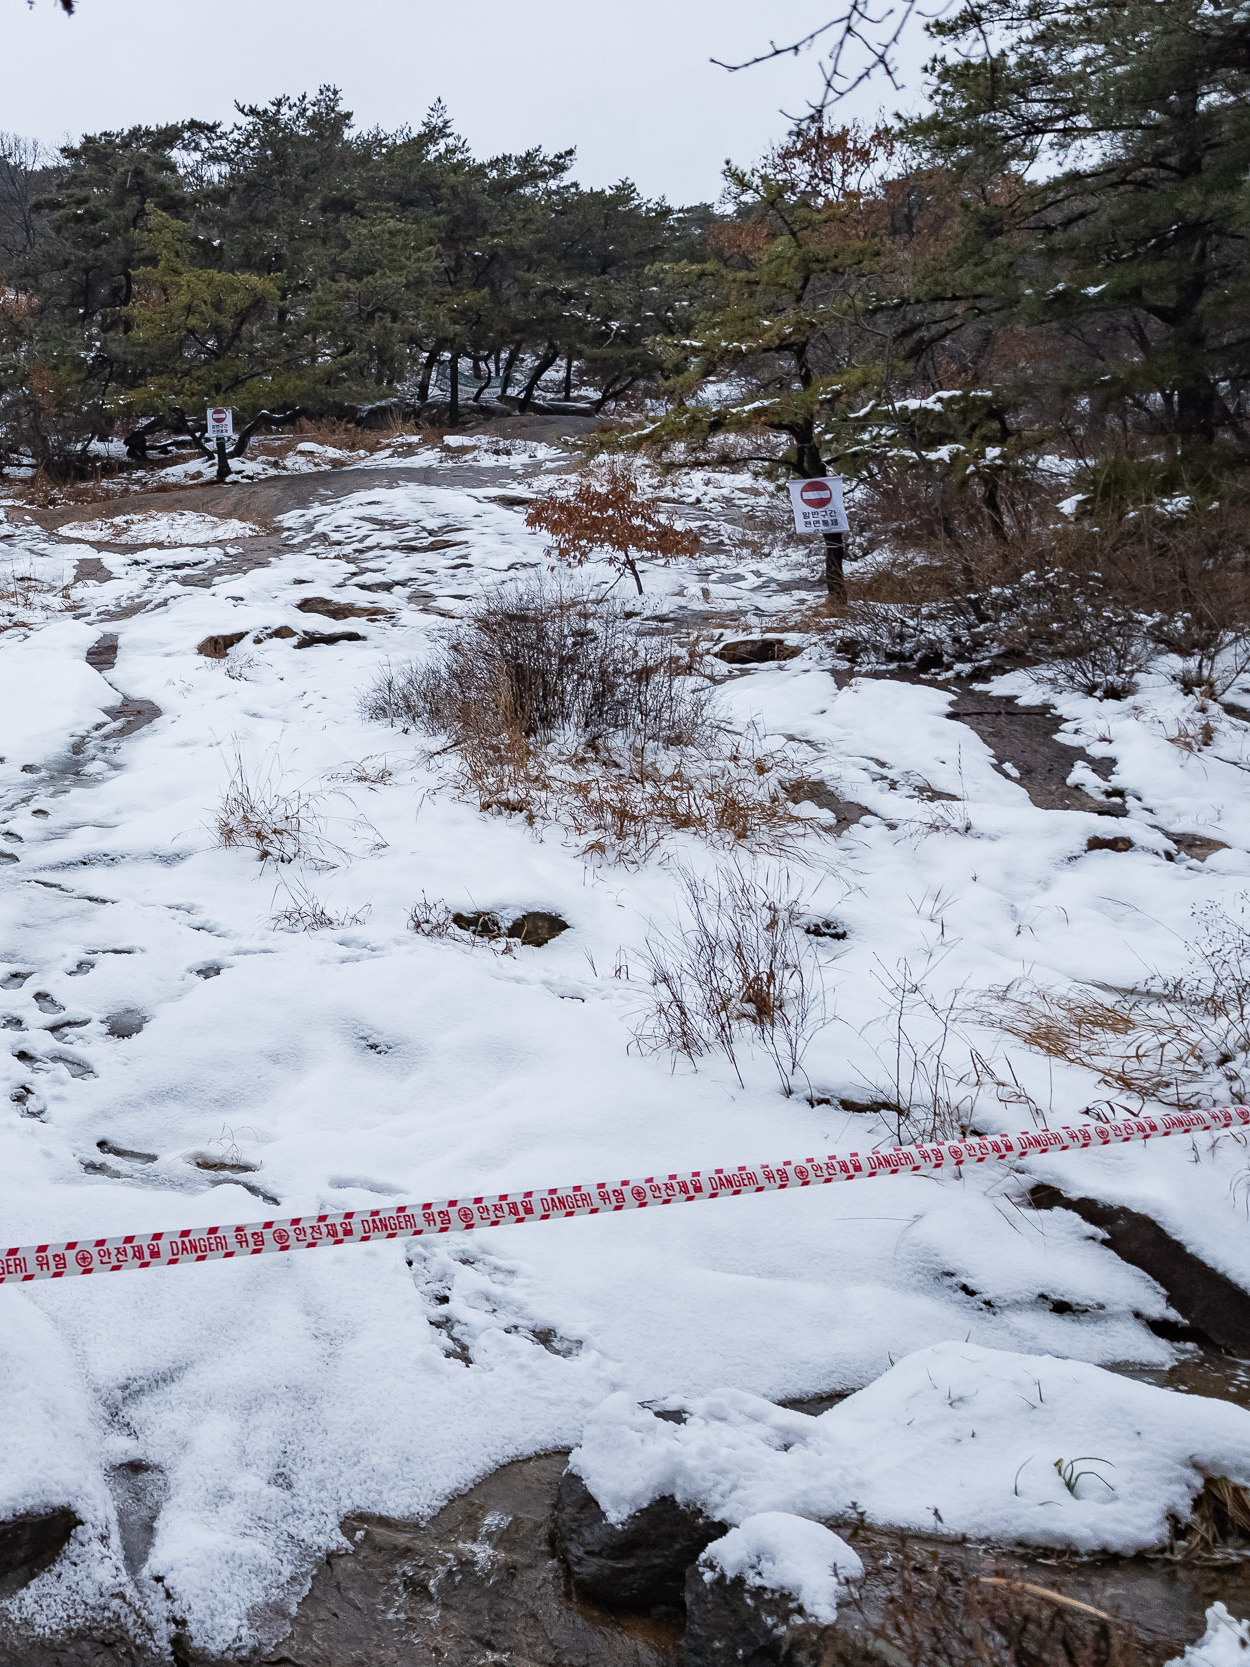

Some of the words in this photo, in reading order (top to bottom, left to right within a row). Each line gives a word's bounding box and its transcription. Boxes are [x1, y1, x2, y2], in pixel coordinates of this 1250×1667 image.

[802, 509, 837, 520] 암반구간
[804, 519, 838, 528] 전면통제
[35, 1253, 67, 1271] 위험
[97, 1243, 161, 1265] 안전제일
[234, 1231, 265, 1248] 위험
[293, 1221, 353, 1242] 안전제일
[422, 1210, 451, 1227] 위험
[477, 1200, 534, 1220] 안전제일
[598, 1188, 625, 1205] 위험
[649, 1179, 703, 1199] 안전제일
[763, 1168, 789, 1184] 위험
[811, 1158, 862, 1178] 안전제일
